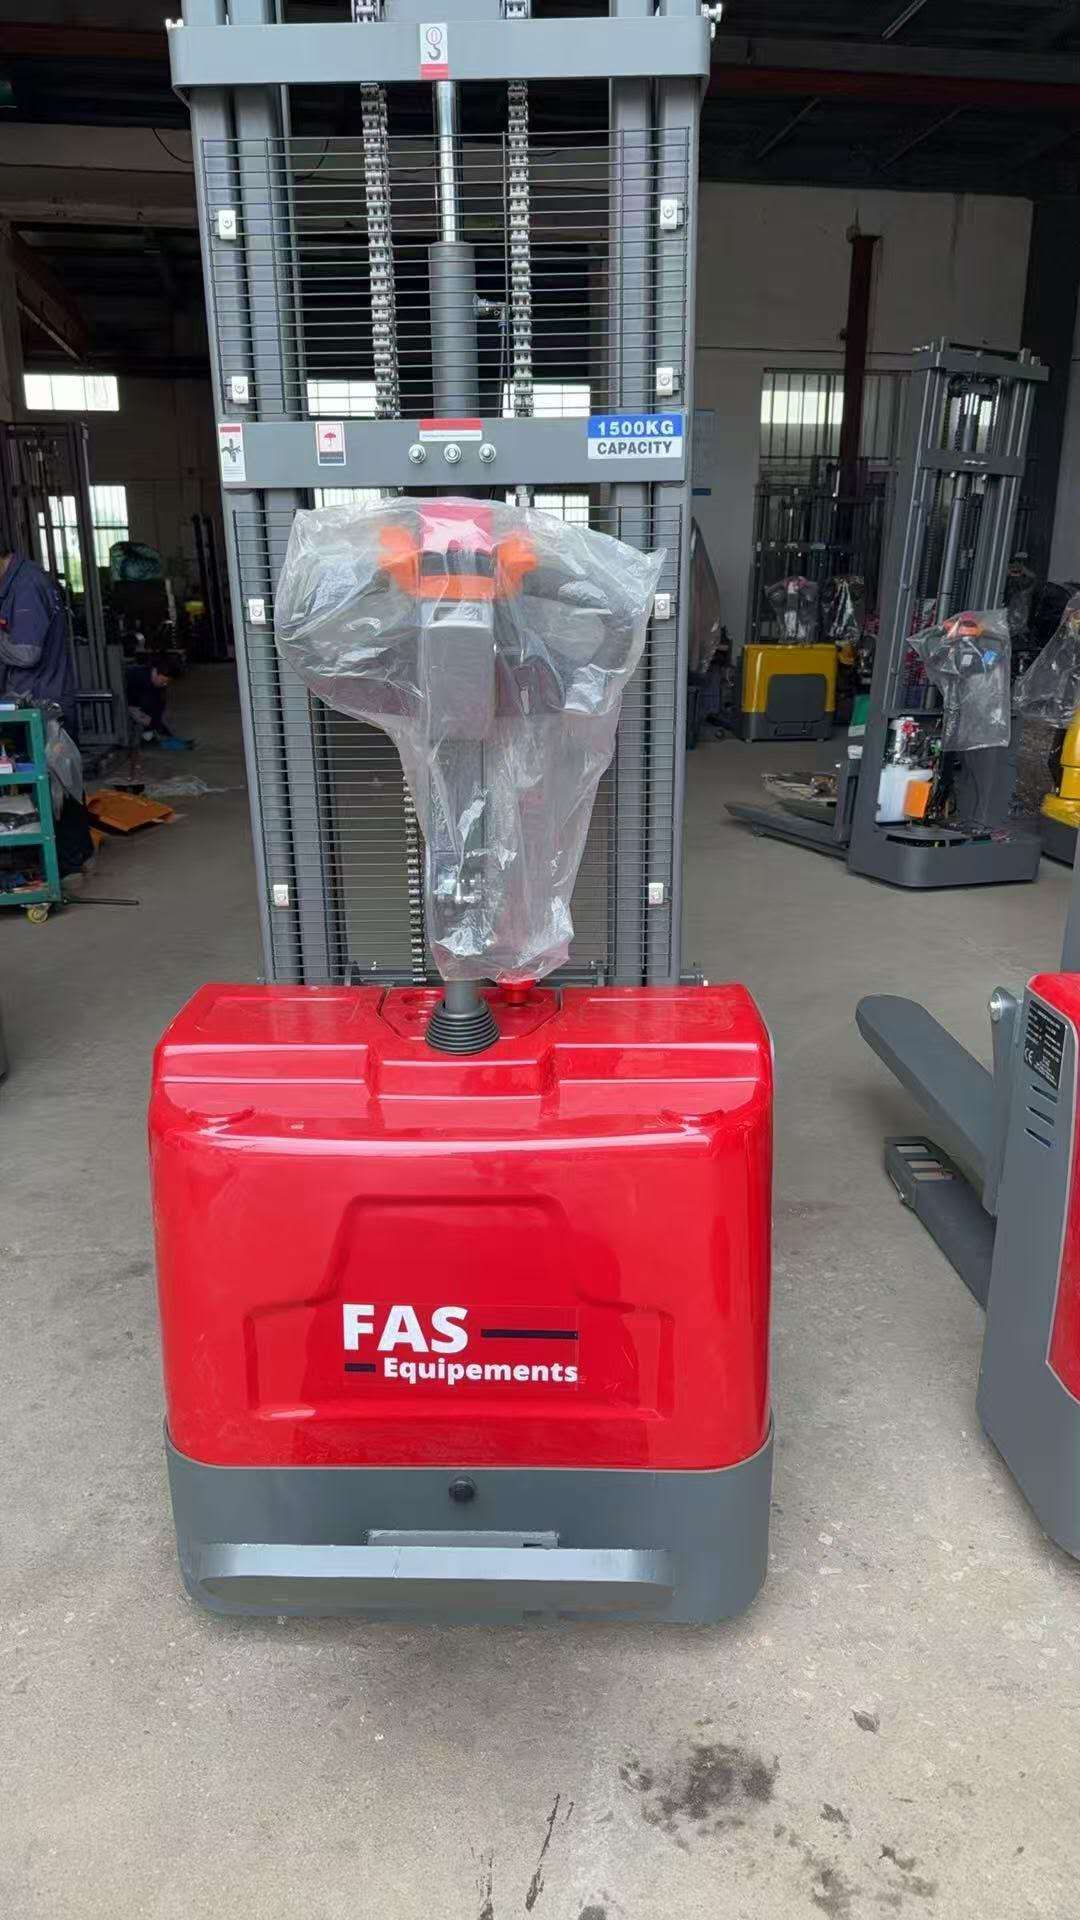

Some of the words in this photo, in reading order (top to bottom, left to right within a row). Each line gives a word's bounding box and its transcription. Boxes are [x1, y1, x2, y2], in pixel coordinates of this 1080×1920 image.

[598, 420, 674, 436] 1500KG
[597, 441, 672, 455] CAPACITY
[342, 1303, 469, 1354] FAS
[383, 1357, 578, 1385] Equipements
